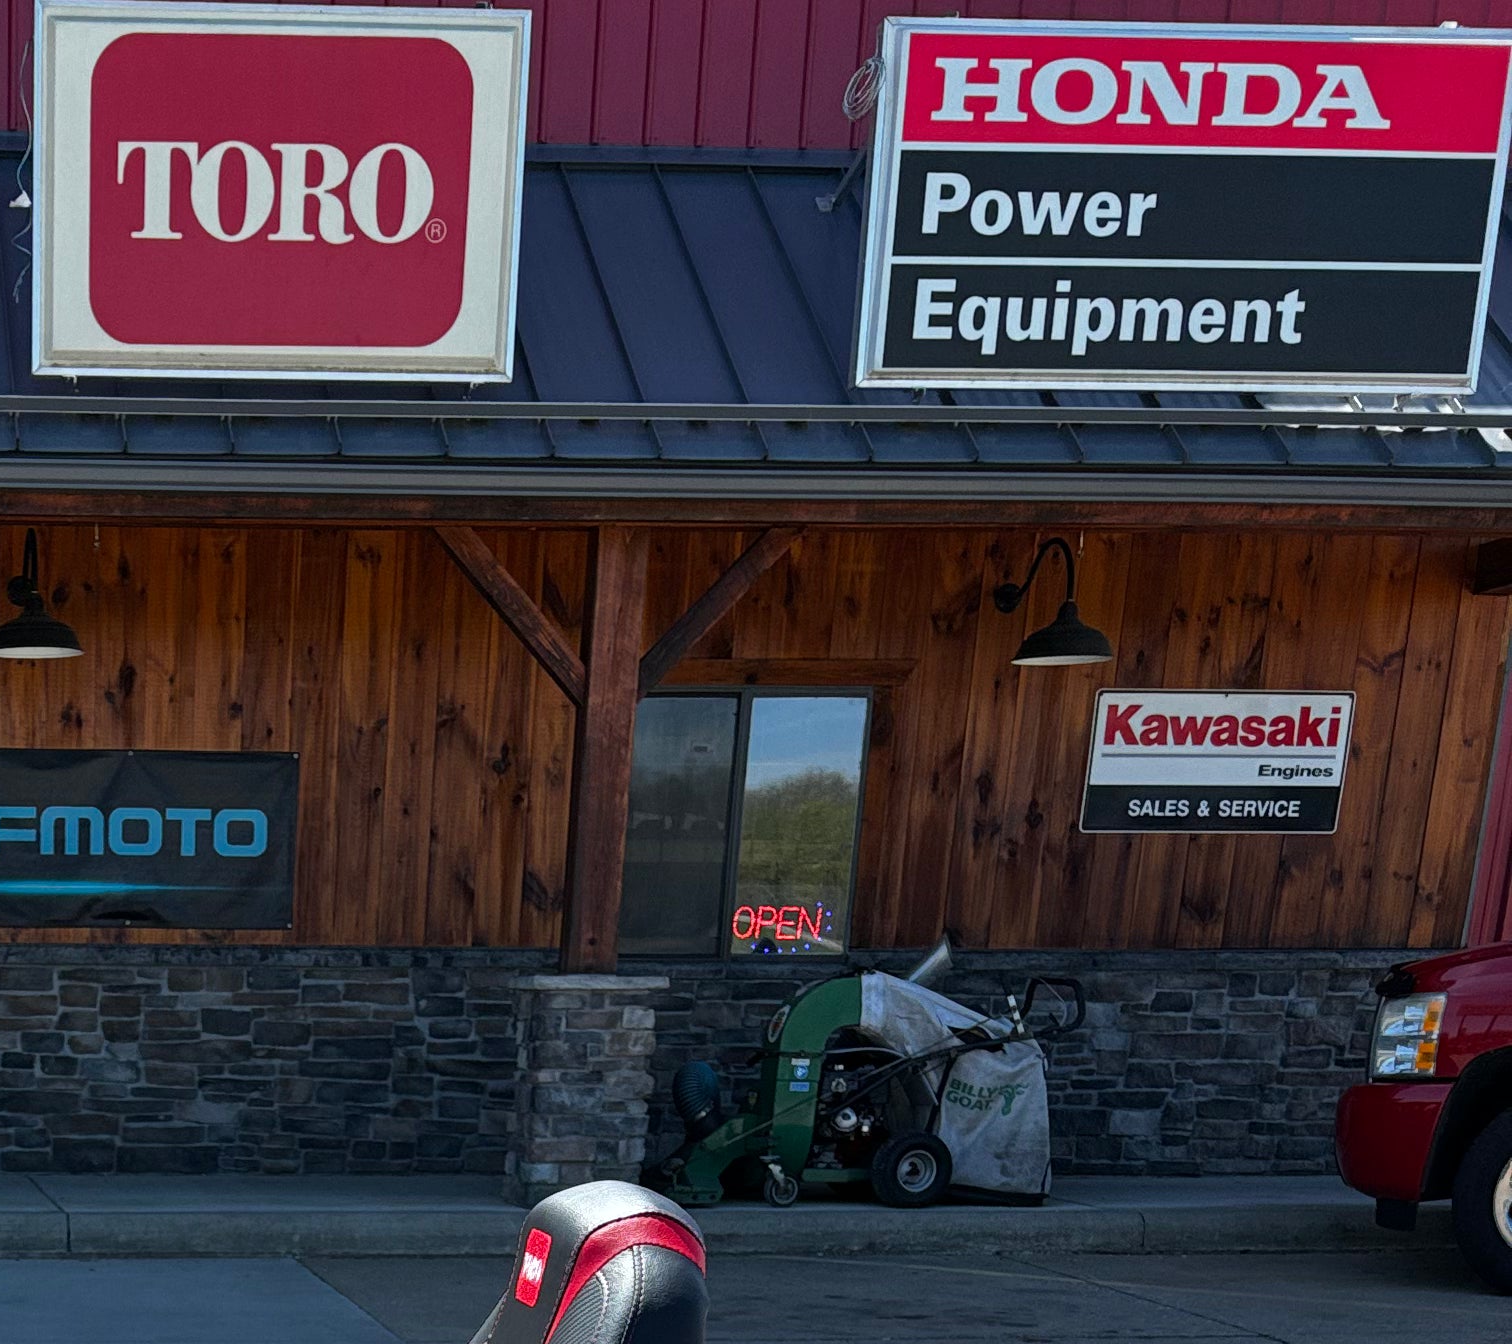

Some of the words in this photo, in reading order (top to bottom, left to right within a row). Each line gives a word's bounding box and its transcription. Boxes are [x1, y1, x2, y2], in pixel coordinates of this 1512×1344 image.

[930, 57, 1390, 130] HONDA
[921, 172, 1157, 237] Power
[911, 278, 1306, 356] Equipment
[1103, 704, 1341, 748] Kawasaki
[1257, 764, 1334, 781] Engines
[1128, 798, 1190, 818] SALES
[1197, 799, 1210, 817] &
[1218, 798, 1301, 818] SERVICE
[732, 905, 822, 940] OPEN
[945, 1090, 992, 1112] GOAT
[949, 1078, 1000, 1099] BILLY
